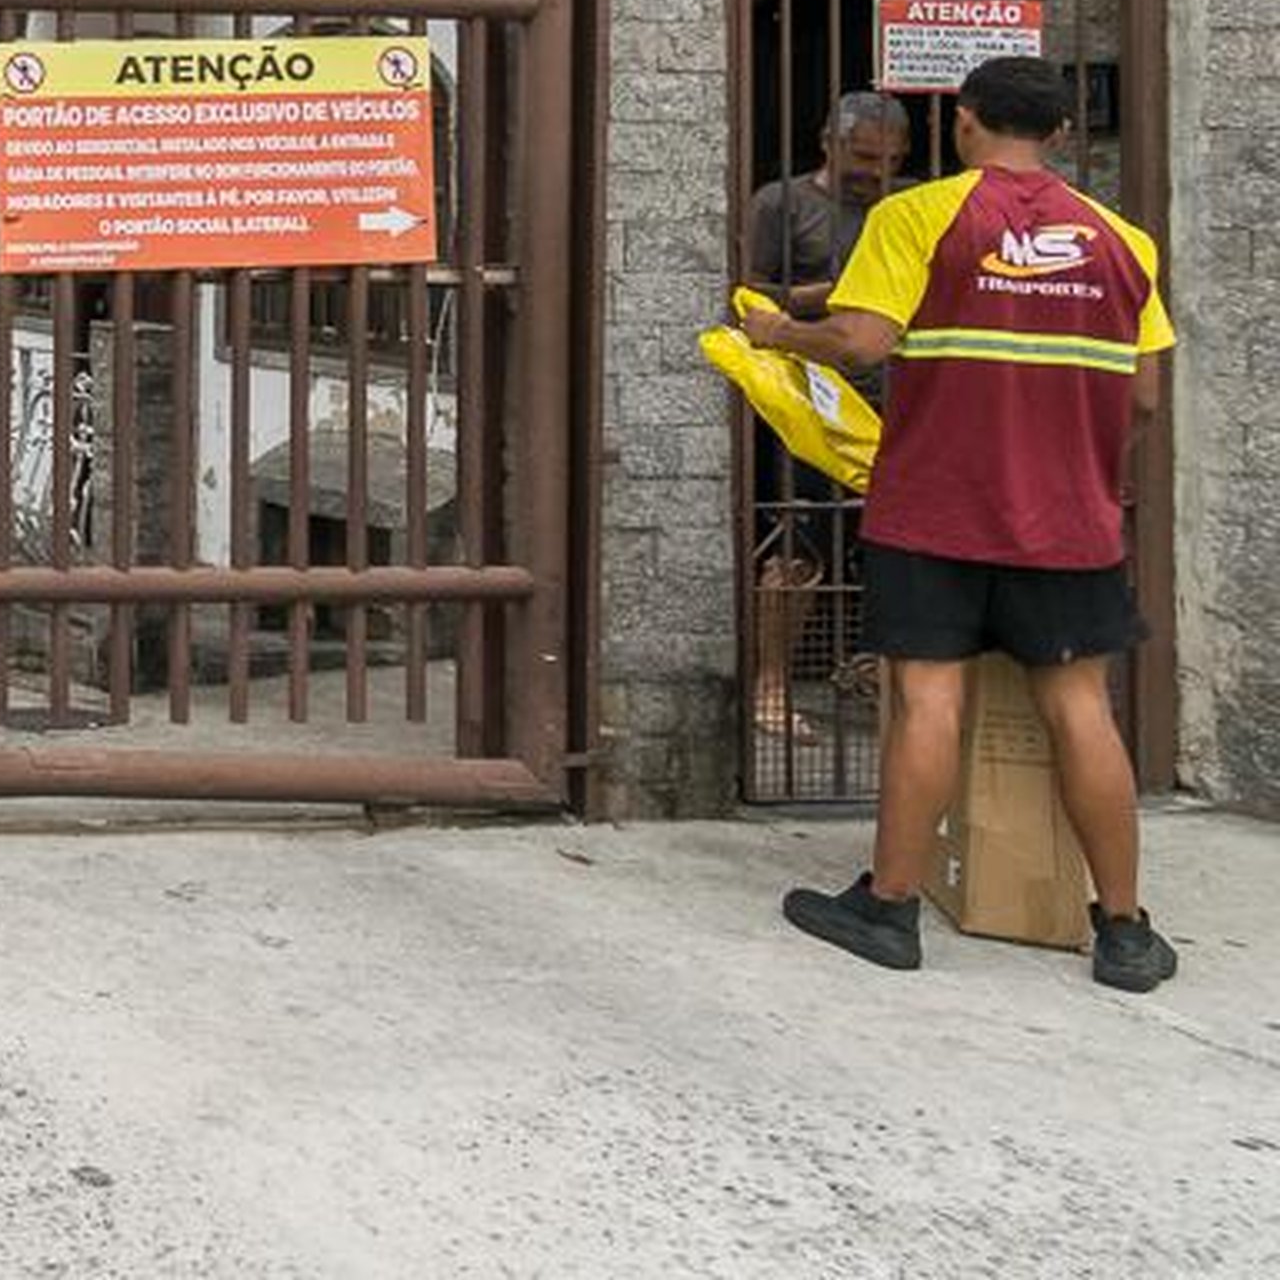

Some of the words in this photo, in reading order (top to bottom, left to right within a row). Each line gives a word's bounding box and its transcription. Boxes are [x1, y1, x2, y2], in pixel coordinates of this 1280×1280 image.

[907, 0, 1022, 25] ATENÇÃO
[115, 46, 315, 90] ATENÇÃO
[4, 101, 83, 128] PORTÃO
[85, 105, 113, 126] DE
[115, 104, 191, 126] ACESSO
[194, 102, 300, 124] EXCLUSIVO
[302, 101, 328, 122] DE
[329, 96, 420, 121] VEÍCULOS
[99, 219, 111, 234] O
[114, 214, 173, 234] PORTÃO
[1001, 228, 1084, 267] MS
